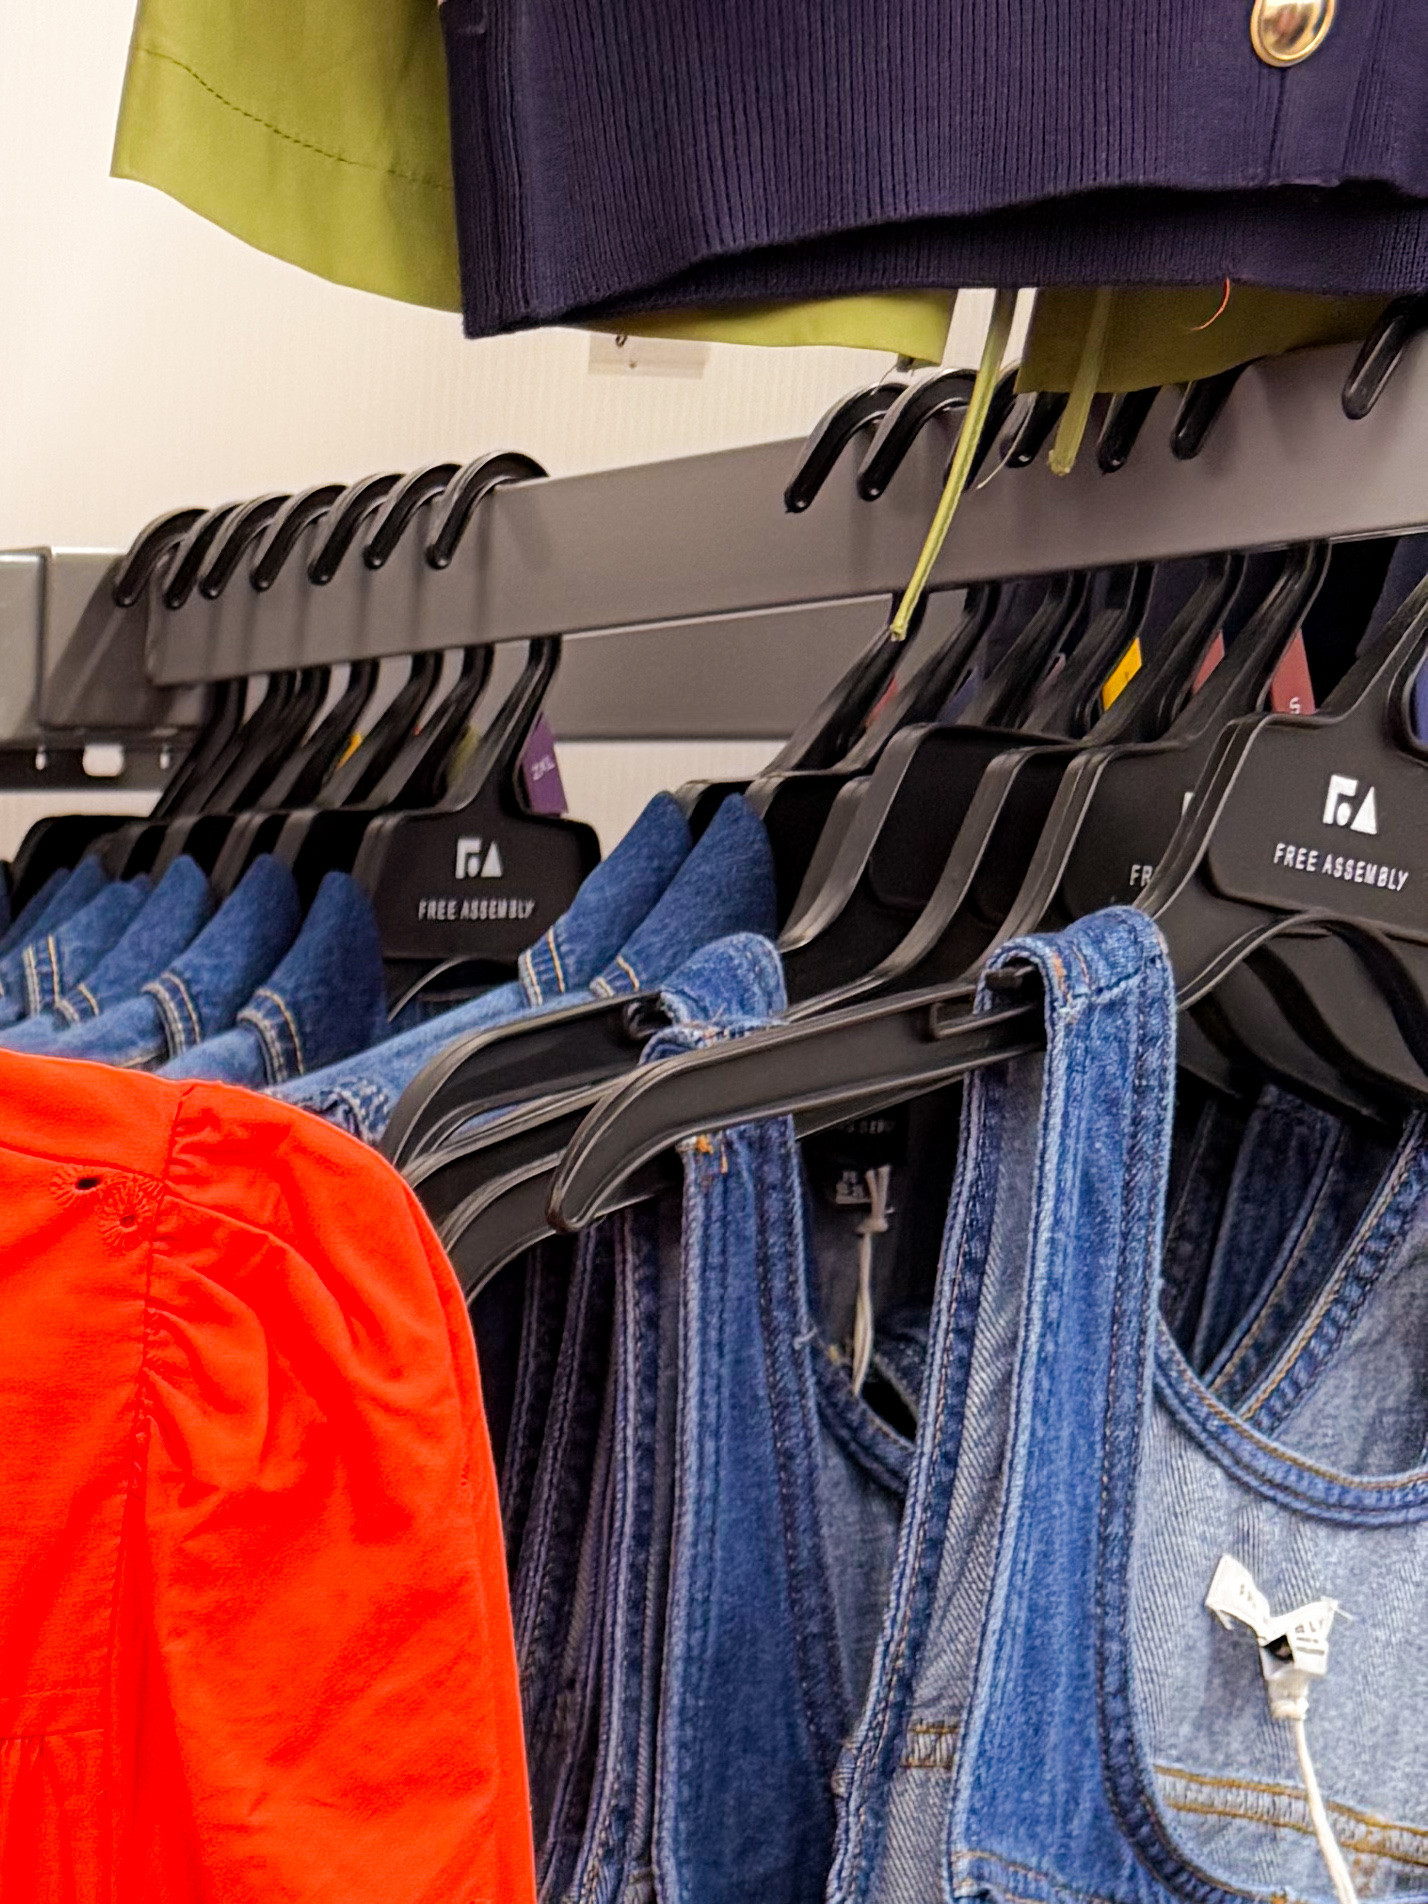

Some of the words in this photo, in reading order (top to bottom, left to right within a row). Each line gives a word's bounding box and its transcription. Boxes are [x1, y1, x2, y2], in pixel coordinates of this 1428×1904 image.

[1129, 863, 1155, 887] FR
[1273, 843, 1319, 872] FREE
[1322, 853, 1409, 891] ASSEMBLY
[418, 899, 457, 921] FREE
[460, 899, 536, 921] ASSEMBLY
